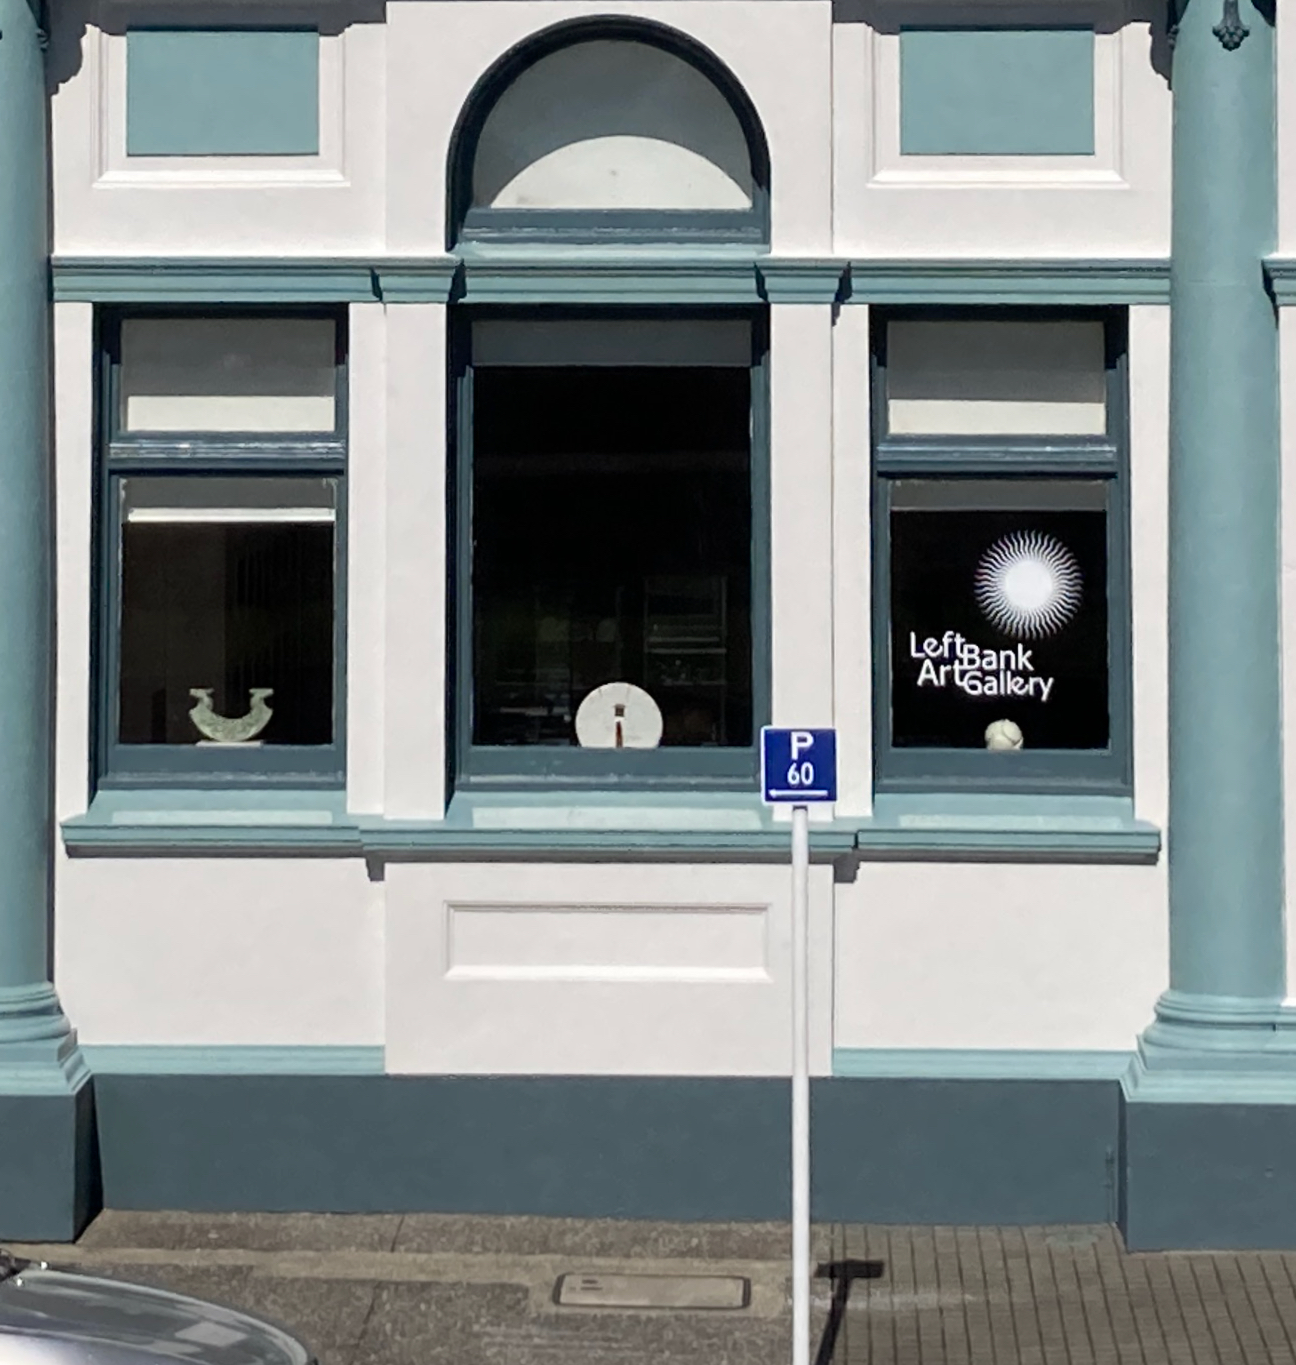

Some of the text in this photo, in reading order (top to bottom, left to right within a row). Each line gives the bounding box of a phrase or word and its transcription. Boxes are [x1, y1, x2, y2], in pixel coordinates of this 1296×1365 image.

[910, 630, 1035, 671] Left Bank
[916, 658, 1054, 702] Art Gallery
[791, 731, 814, 760] P
[787, 762, 814, 785] 60
